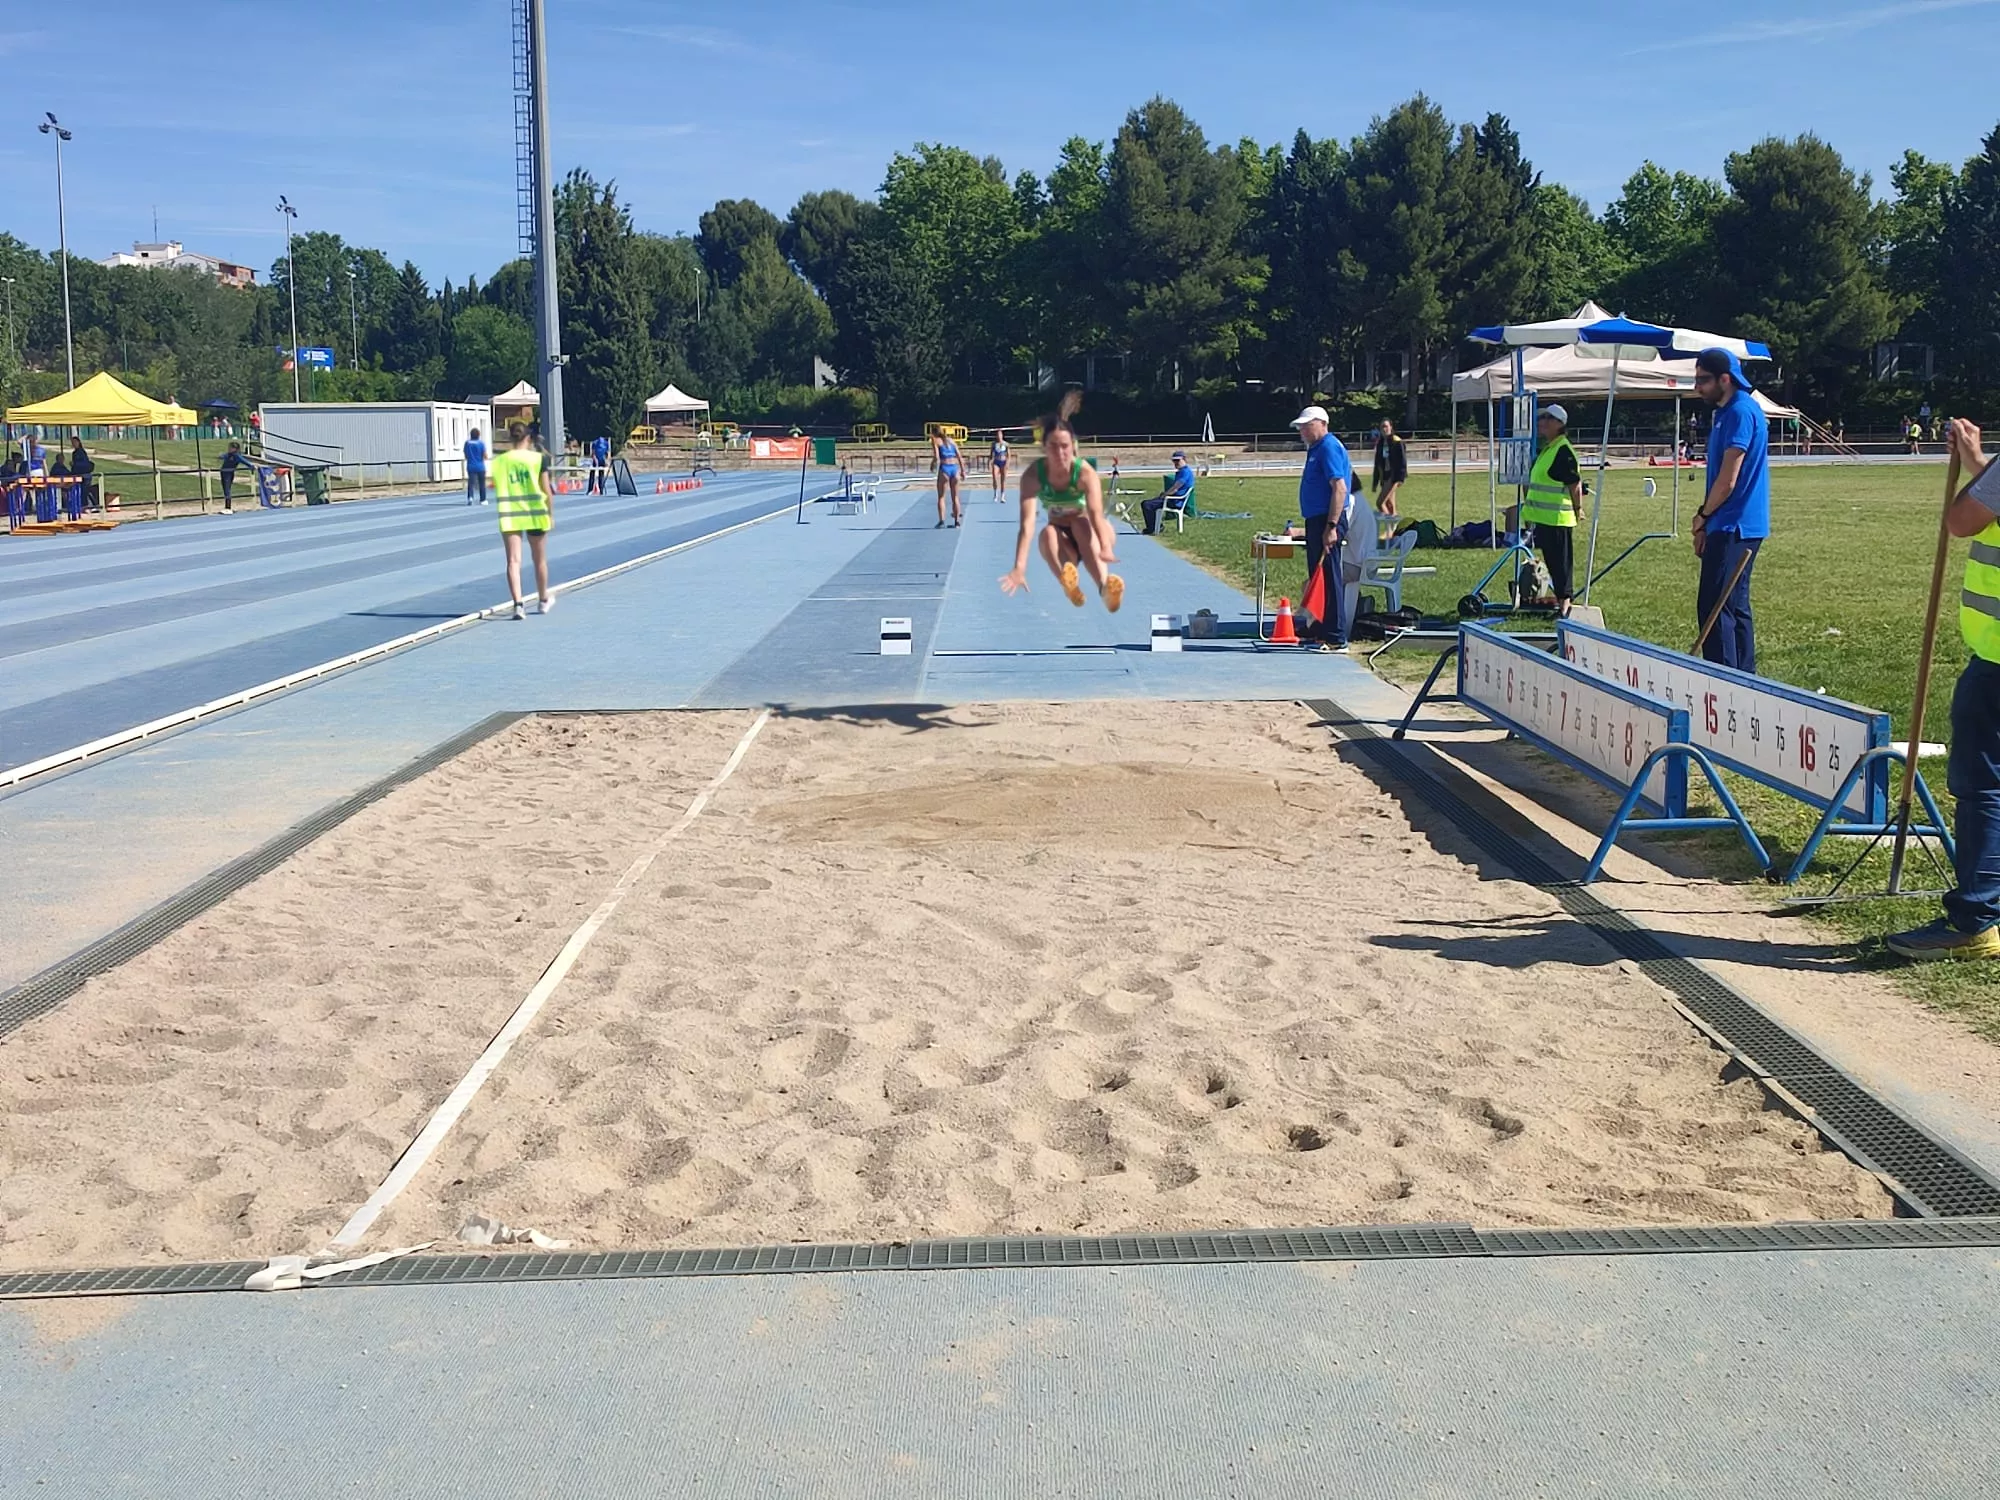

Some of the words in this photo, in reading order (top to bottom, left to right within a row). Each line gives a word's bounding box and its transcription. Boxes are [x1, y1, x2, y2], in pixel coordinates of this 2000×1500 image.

[1464, 647, 1470, 680] 5
[1507, 667, 1514, 704] 6
[1561, 691, 1568, 731] 7
[1575, 707, 1582, 731] 25
[1591, 714, 1598, 739] 50
[1608, 722, 1615, 748] 75
[1624, 722, 1633, 767] 8
[1704, 692, 1718, 735] 15
[1728, 708, 1737, 733] 25
[1750, 717, 1760, 742] 50
[1776, 725, 1785, 751] 75
[1799, 724, 1816, 772] 16
[1829, 743, 1840, 771] 25
